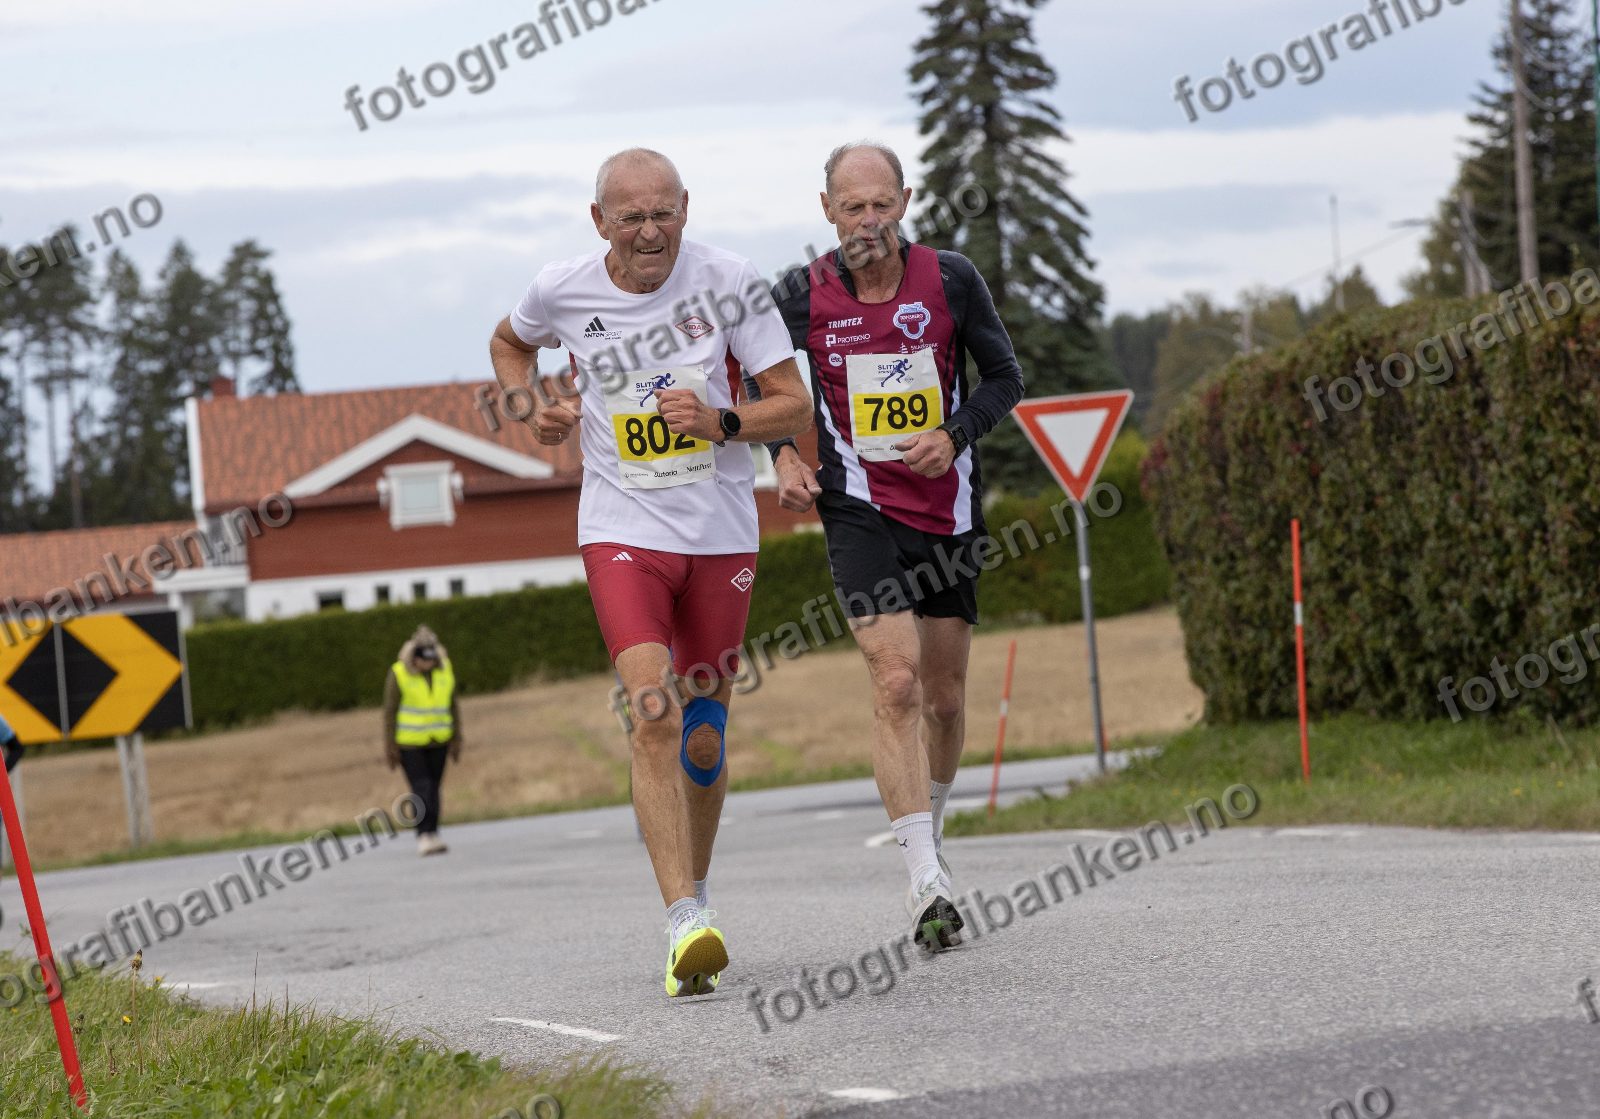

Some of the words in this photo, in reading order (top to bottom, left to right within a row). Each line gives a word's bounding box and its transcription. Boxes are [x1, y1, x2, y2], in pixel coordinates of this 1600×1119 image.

[827, 316, 863, 329] TRIMTEX
[837, 333, 871, 344] PROTEKNO
[863, 394, 929, 432] 789
